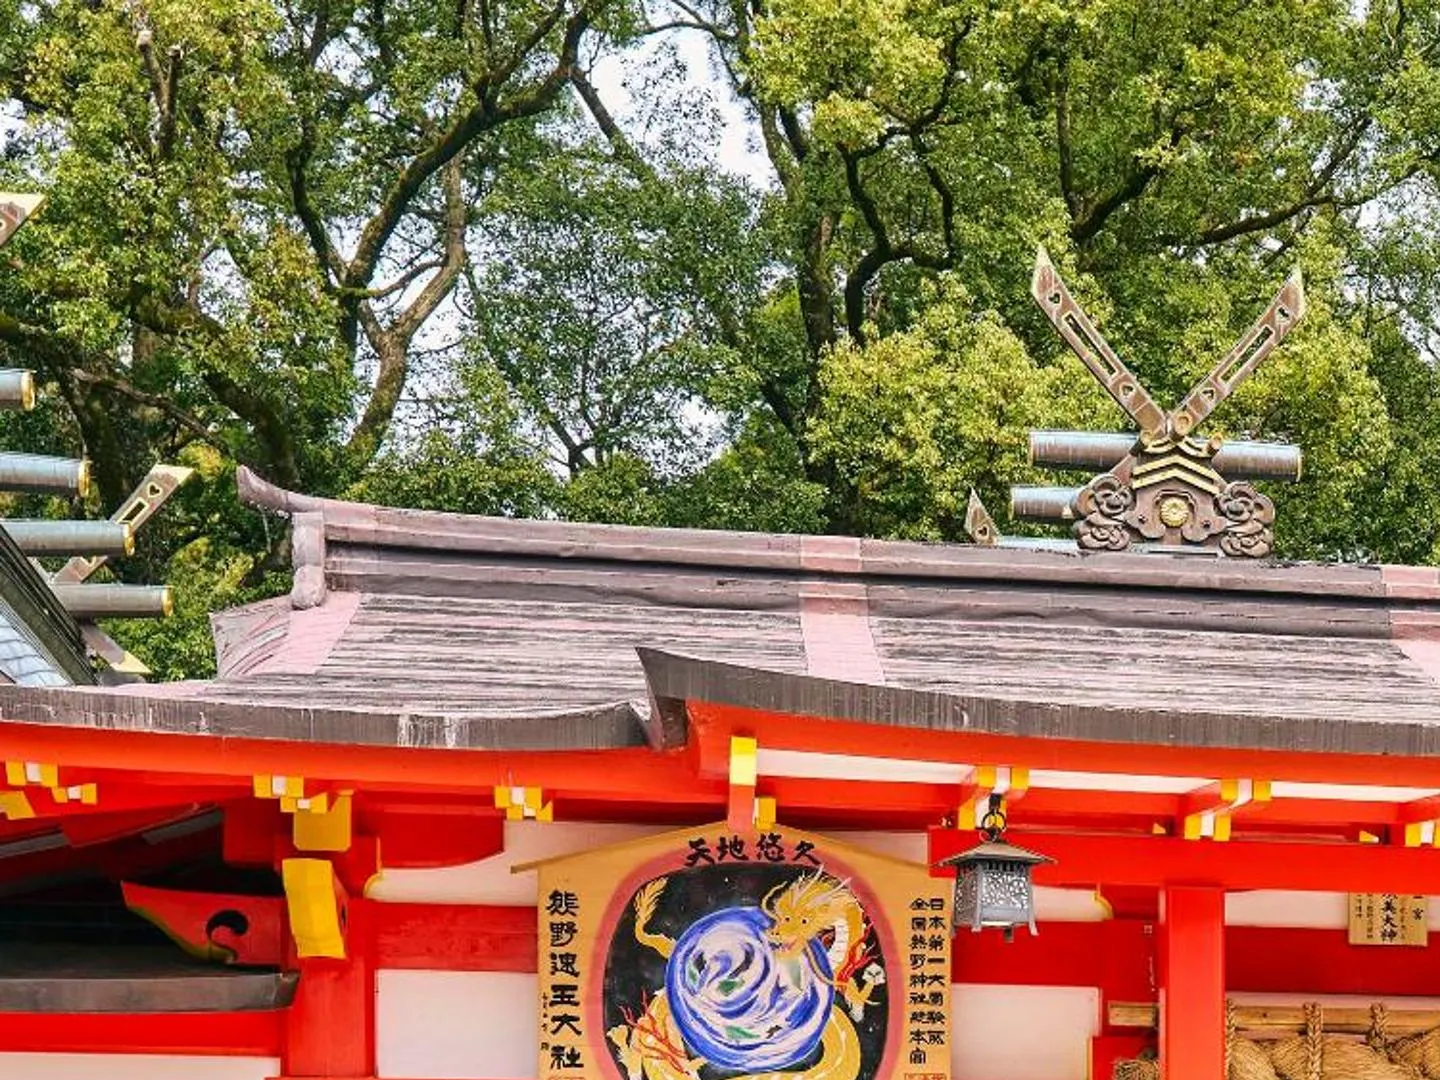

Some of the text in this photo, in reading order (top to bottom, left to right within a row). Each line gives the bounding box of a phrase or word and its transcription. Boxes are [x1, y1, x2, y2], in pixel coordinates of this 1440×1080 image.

[684, 832, 822, 867] 天地悠久
[546, 889, 584, 1069] 熊野速玉大社
